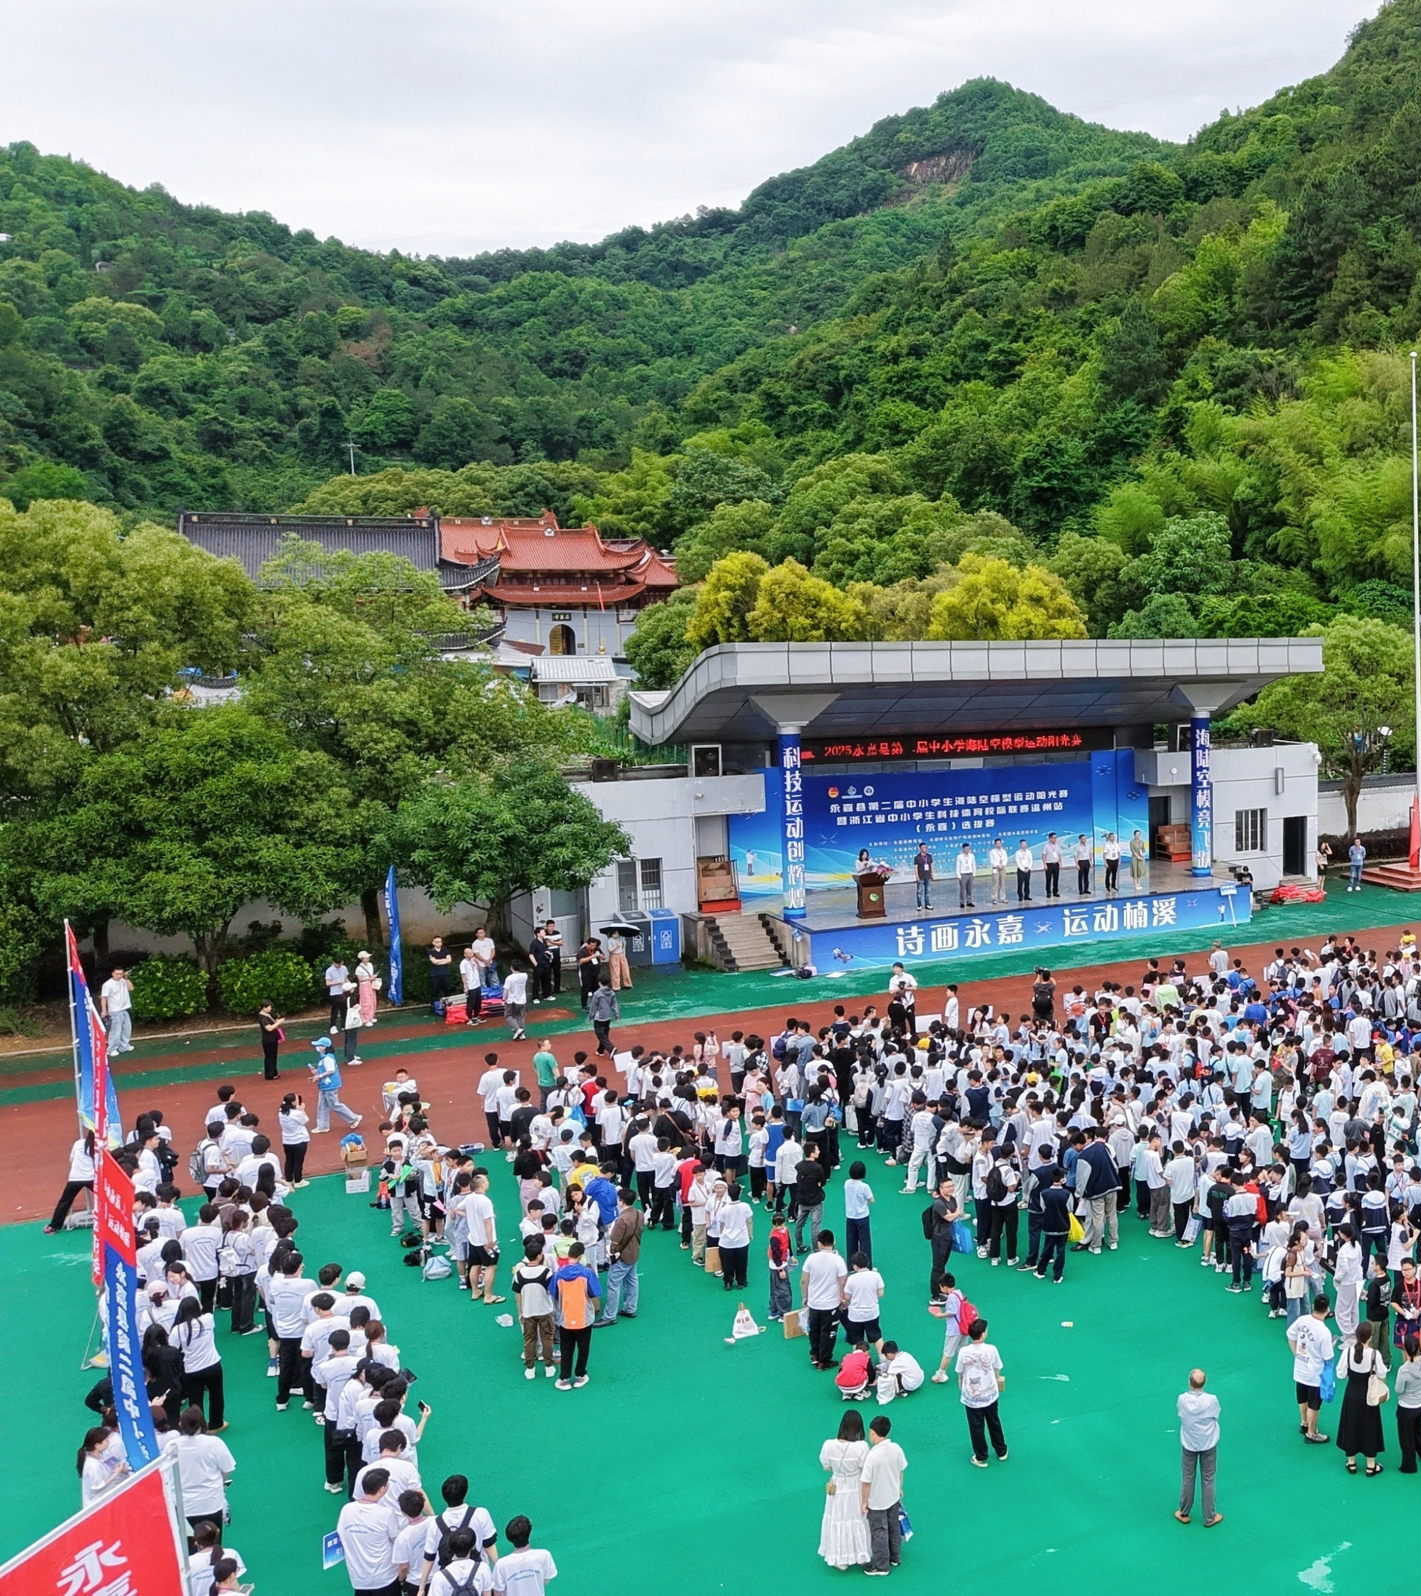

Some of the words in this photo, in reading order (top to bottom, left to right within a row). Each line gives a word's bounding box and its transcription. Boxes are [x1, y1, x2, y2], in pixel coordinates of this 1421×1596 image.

[830, 789, 1068, 814] 永嘉县第二届中小学生海陆空模型运动阳光赛
[896, 914, 1025, 957] 诗画永嘉
[1061, 897, 1178, 937] 运动楠溪
